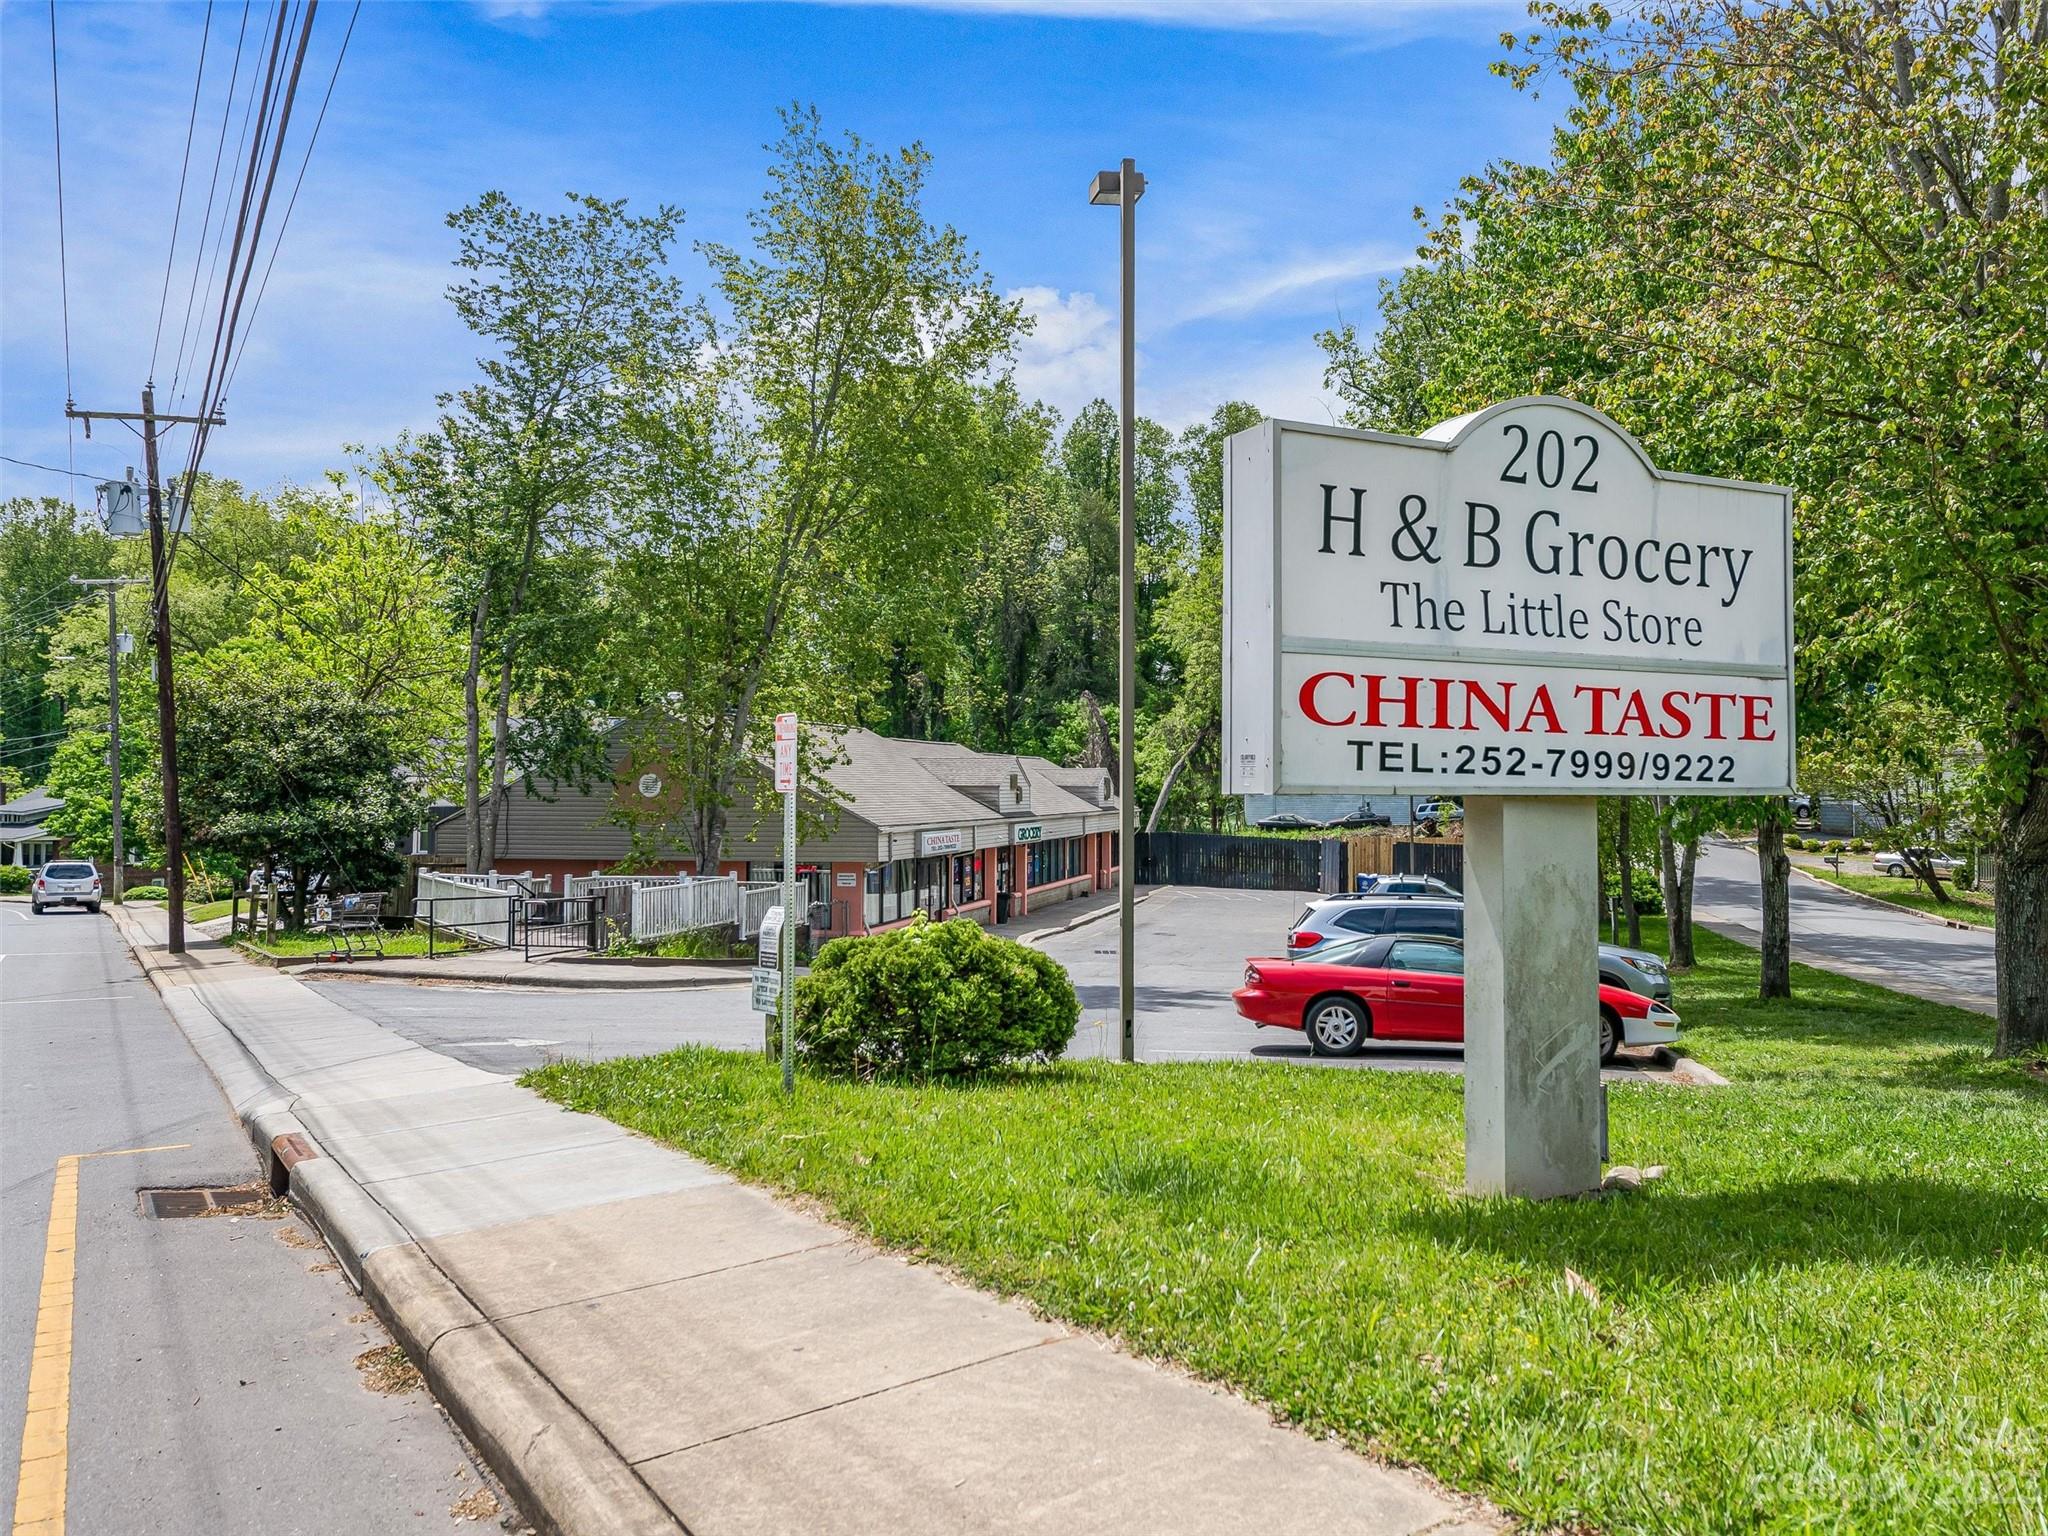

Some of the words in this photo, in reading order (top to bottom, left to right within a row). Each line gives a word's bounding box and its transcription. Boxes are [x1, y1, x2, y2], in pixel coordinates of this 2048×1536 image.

[1499, 423, 1599, 494] 202
[1317, 483, 1368, 557] H
[1391, 494, 1442, 565] &
[1463, 501, 1501, 568] B
[1525, 509, 1754, 608] Grocery
[1380, 581, 1466, 632] The
[1479, 589, 1590, 640] Little
[1602, 599, 1704, 647] Store
[1298, 671, 1567, 734] CHINA
[1573, 684, 1777, 742] TASTE
[779, 762, 792, 777] TIME
[780, 745, 792, 758] ANY
[1347, 739, 1735, 783] TEL:252-7999/9222
[1017, 825, 1042, 841] GROCERY
